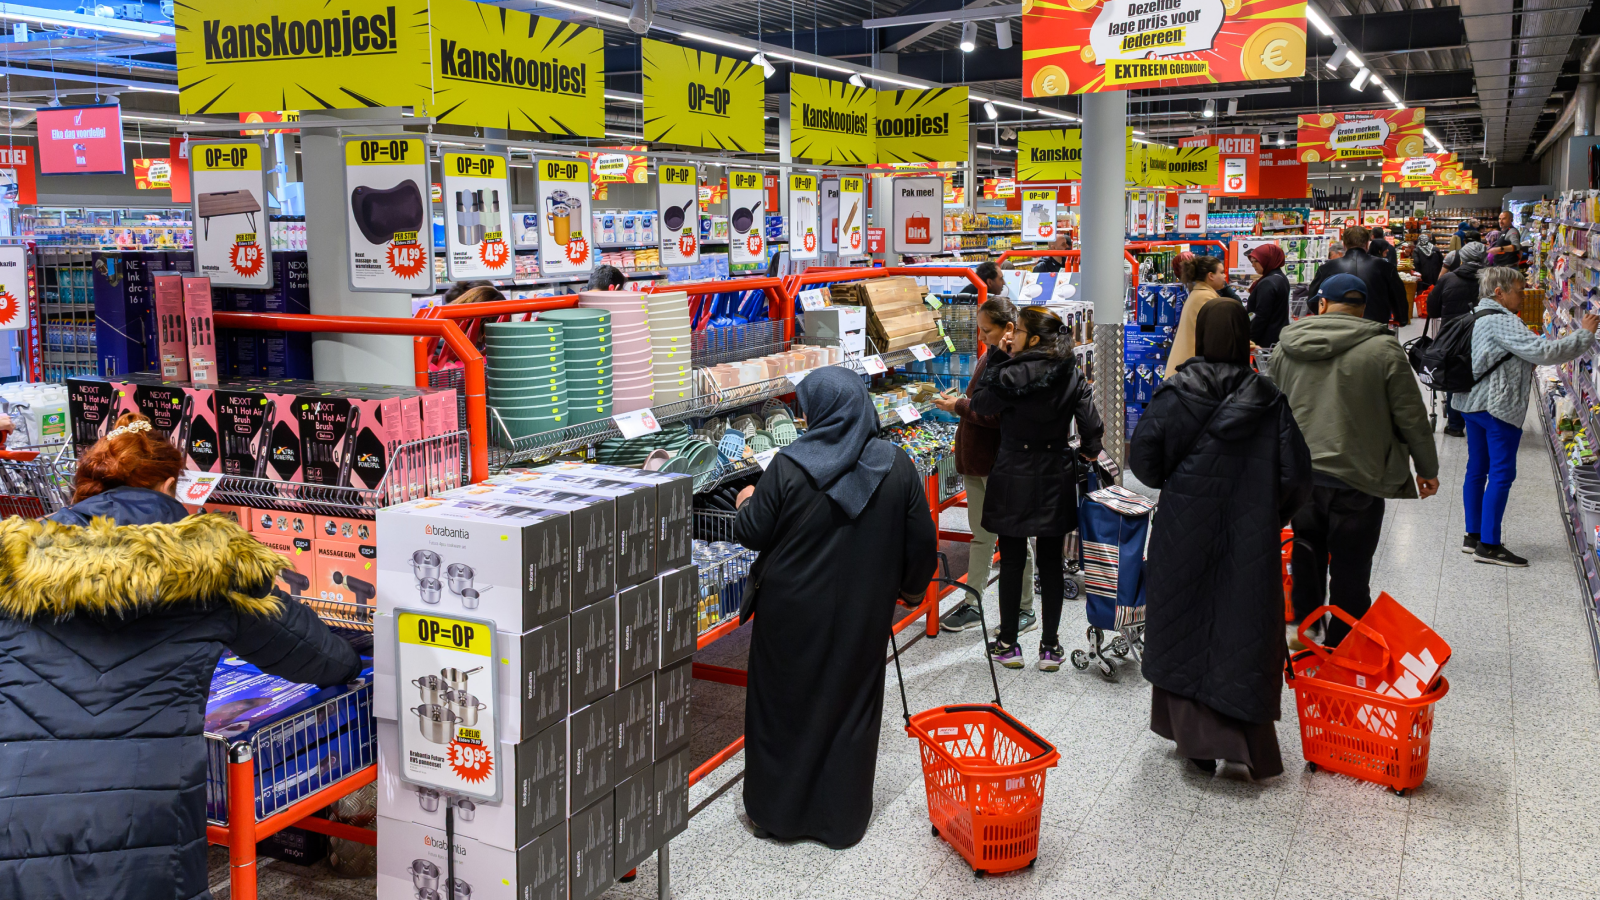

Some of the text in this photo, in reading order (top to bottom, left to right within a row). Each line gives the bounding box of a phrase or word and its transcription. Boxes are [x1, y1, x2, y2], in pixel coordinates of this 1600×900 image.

[1108, 9, 1202, 36] lage prijs voor
[203, 6, 397, 60] Kanskoopjes!
[1122, 28, 1182, 49] iedereen
[440, 38, 587, 94] Kanskoopjes!
[1114, 63, 1207, 79] EXTREEM GOEDKOOP!
[688, 81, 731, 115] OP=OP
[802, 103, 868, 134] Kanskoopjes!
[64, 128, 76, 139] dag
[1337, 127, 1354, 136] Grote
[1337, 132, 1380, 142] kleine prijzen
[360, 140, 409, 162] OP=OP
[1217, 138, 1255, 153] ACTIE!
[205, 147, 248, 168] OP=OP
[457, 156, 495, 175] OP=OP
[547, 162, 578, 179] OP=OP
[666, 168, 689, 182] OP=OP
[735, 174, 757, 187] OP=OP
[794, 177, 812, 189] OP=OP
[844, 179, 859, 191] OP=OP
[901, 188, 934, 197] Pak mee!
[1029, 192, 1050, 200] OP=OP
[394, 232, 404, 240] PER
[908, 226, 927, 239] Dirk
[392, 247, 420, 267] 14.99
[485, 244, 504, 262] 4.99
[569, 242, 585, 259] 2.49
[236, 247, 258, 268] 4.99
[289, 281, 296, 289] 16
[79, 385, 99, 393] NEXXT
[149, 391, 171, 399] NEXXT
[89, 395, 99, 403] Hot
[100, 396, 109, 404] Air
[142, 399, 147, 407] 5
[148, 400, 154, 408] In
[160, 401, 171, 410] Hot
[172, 402, 182, 410] Air
[229, 397, 252, 405] NEXXT
[83, 403, 98, 411] Brush
[155, 409, 171, 418] Brush
[226, 406, 233, 414] In
[234, 406, 238, 414] 1
[240, 407, 252, 415] Hot
[253, 408, 263, 416] Air
[233, 415, 251, 424] Brush
[302, 411, 307, 419] 5
[308, 412, 315, 420] In
[322, 413, 334, 422] Hot
[335, 414, 346, 423] Air
[315, 421, 334, 430] Brush
[432, 524, 470, 540] brabantia
[279, 543, 291, 551] GUN
[318, 548, 343, 558] MASSAGE
[344, 551, 356, 559] GUN
[418, 618, 475, 648] OP=OP
[459, 728, 480, 739] 4-DELIG
[409, 750, 445, 763] Brabantia Futura
[453, 744, 487, 770] 39.99
[1005, 776, 1026, 792] Dirk
[431, 836, 467, 856] brabntia
